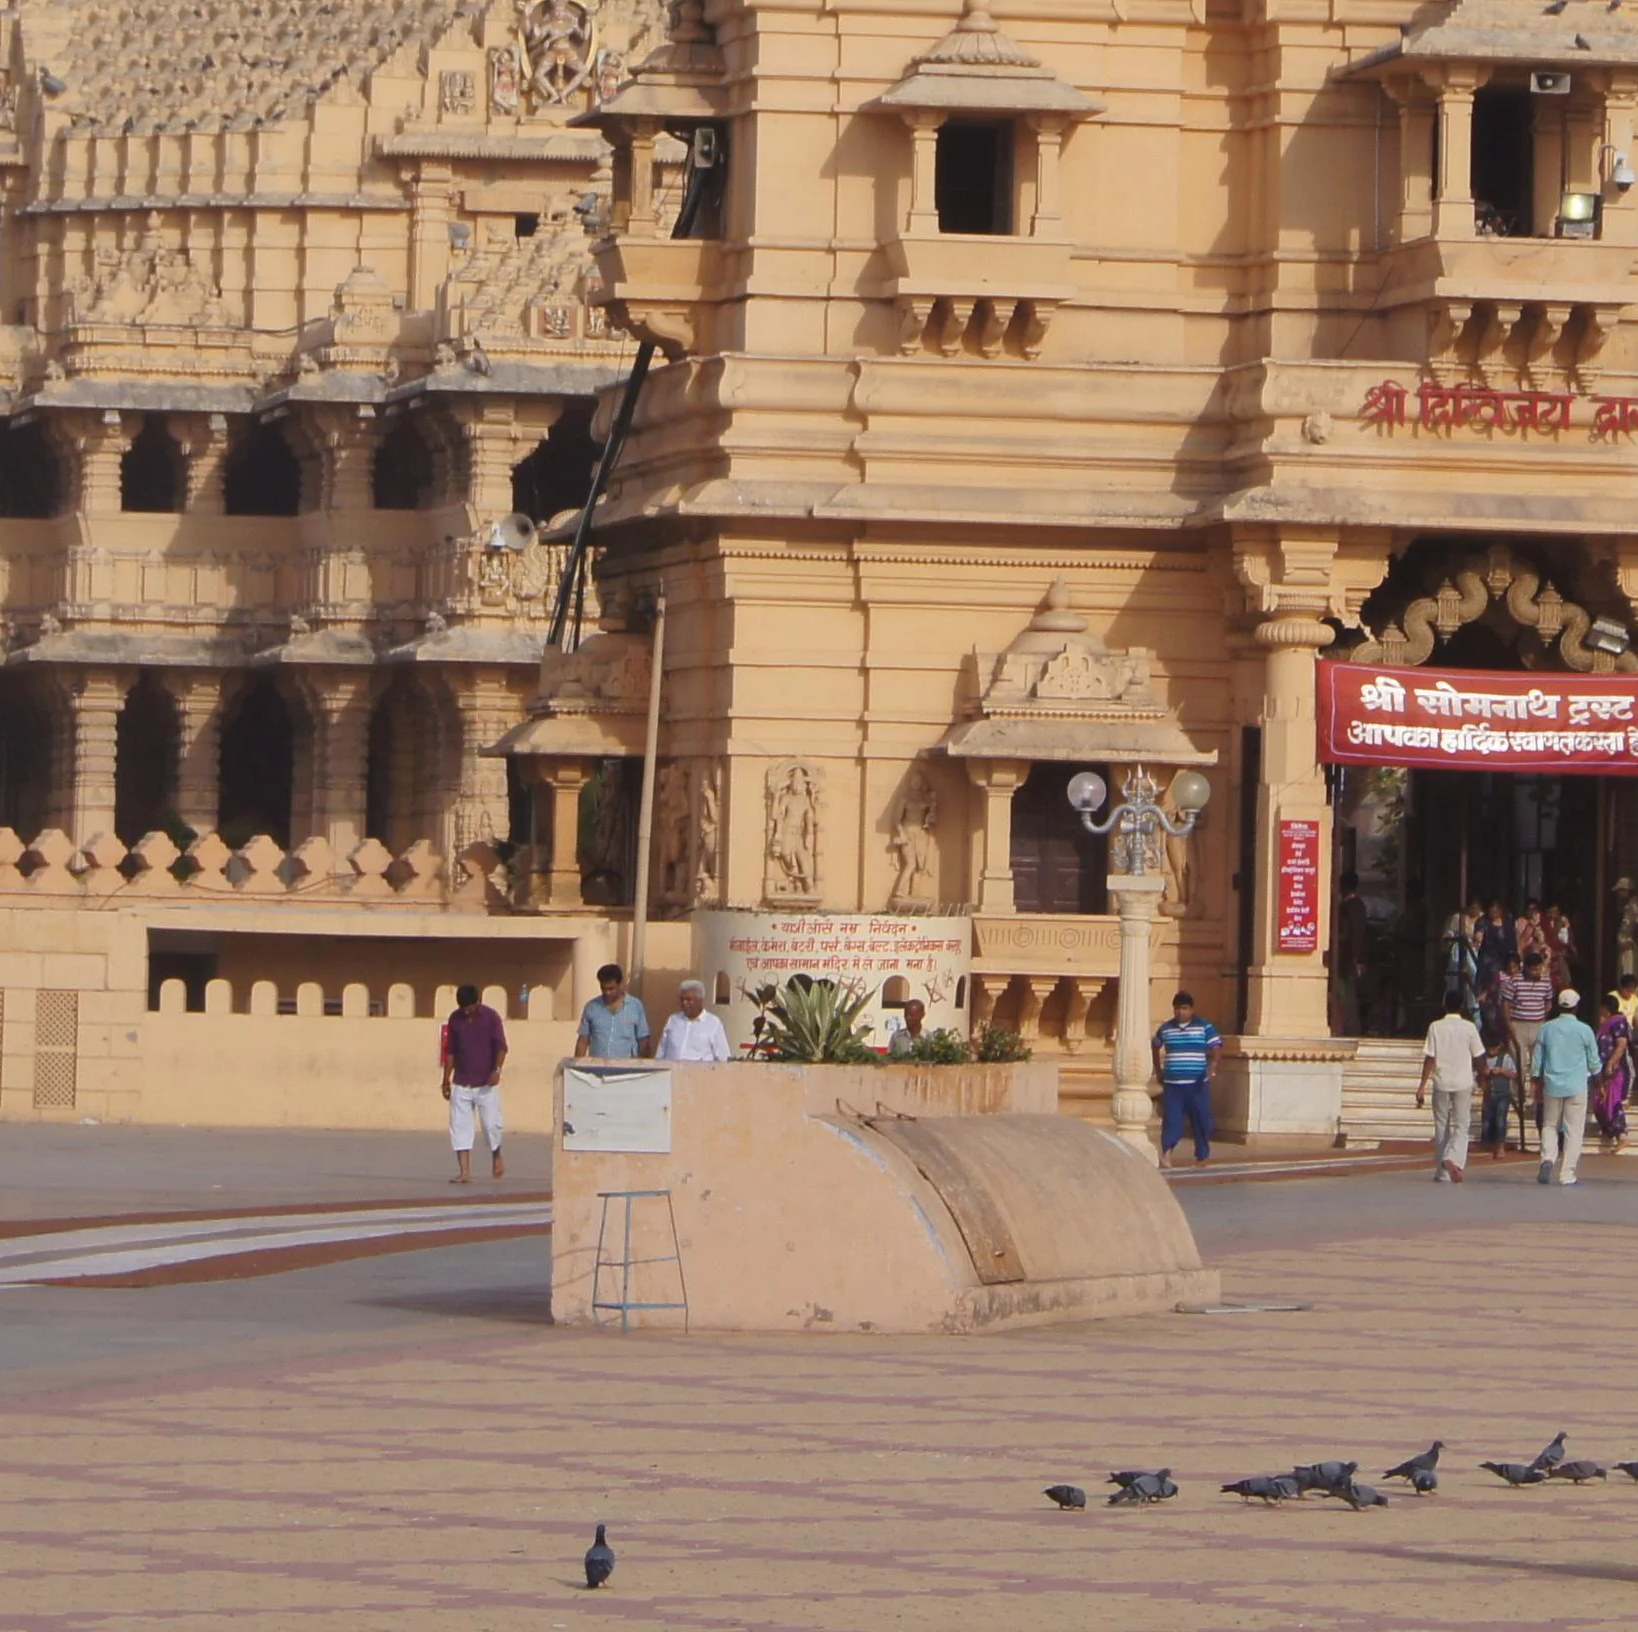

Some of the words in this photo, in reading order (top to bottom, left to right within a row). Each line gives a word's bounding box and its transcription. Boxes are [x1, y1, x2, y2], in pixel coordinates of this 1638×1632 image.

[1359, 379, 1408, 428] श्री
[1416, 381, 1576, 432] दिग्विजय
[1360, 675, 1406, 713] श्री
[1414, 681, 1561, 720] सोमनाथ
[1568, 694, 1635, 725] ट्रस्ट
[1347, 721, 1439, 748] आपका
[1440, 722, 1509, 755] हार्दिक
[1509, 730, 1574, 756] स्वागत
[1575, 731, 1625, 756] करता
